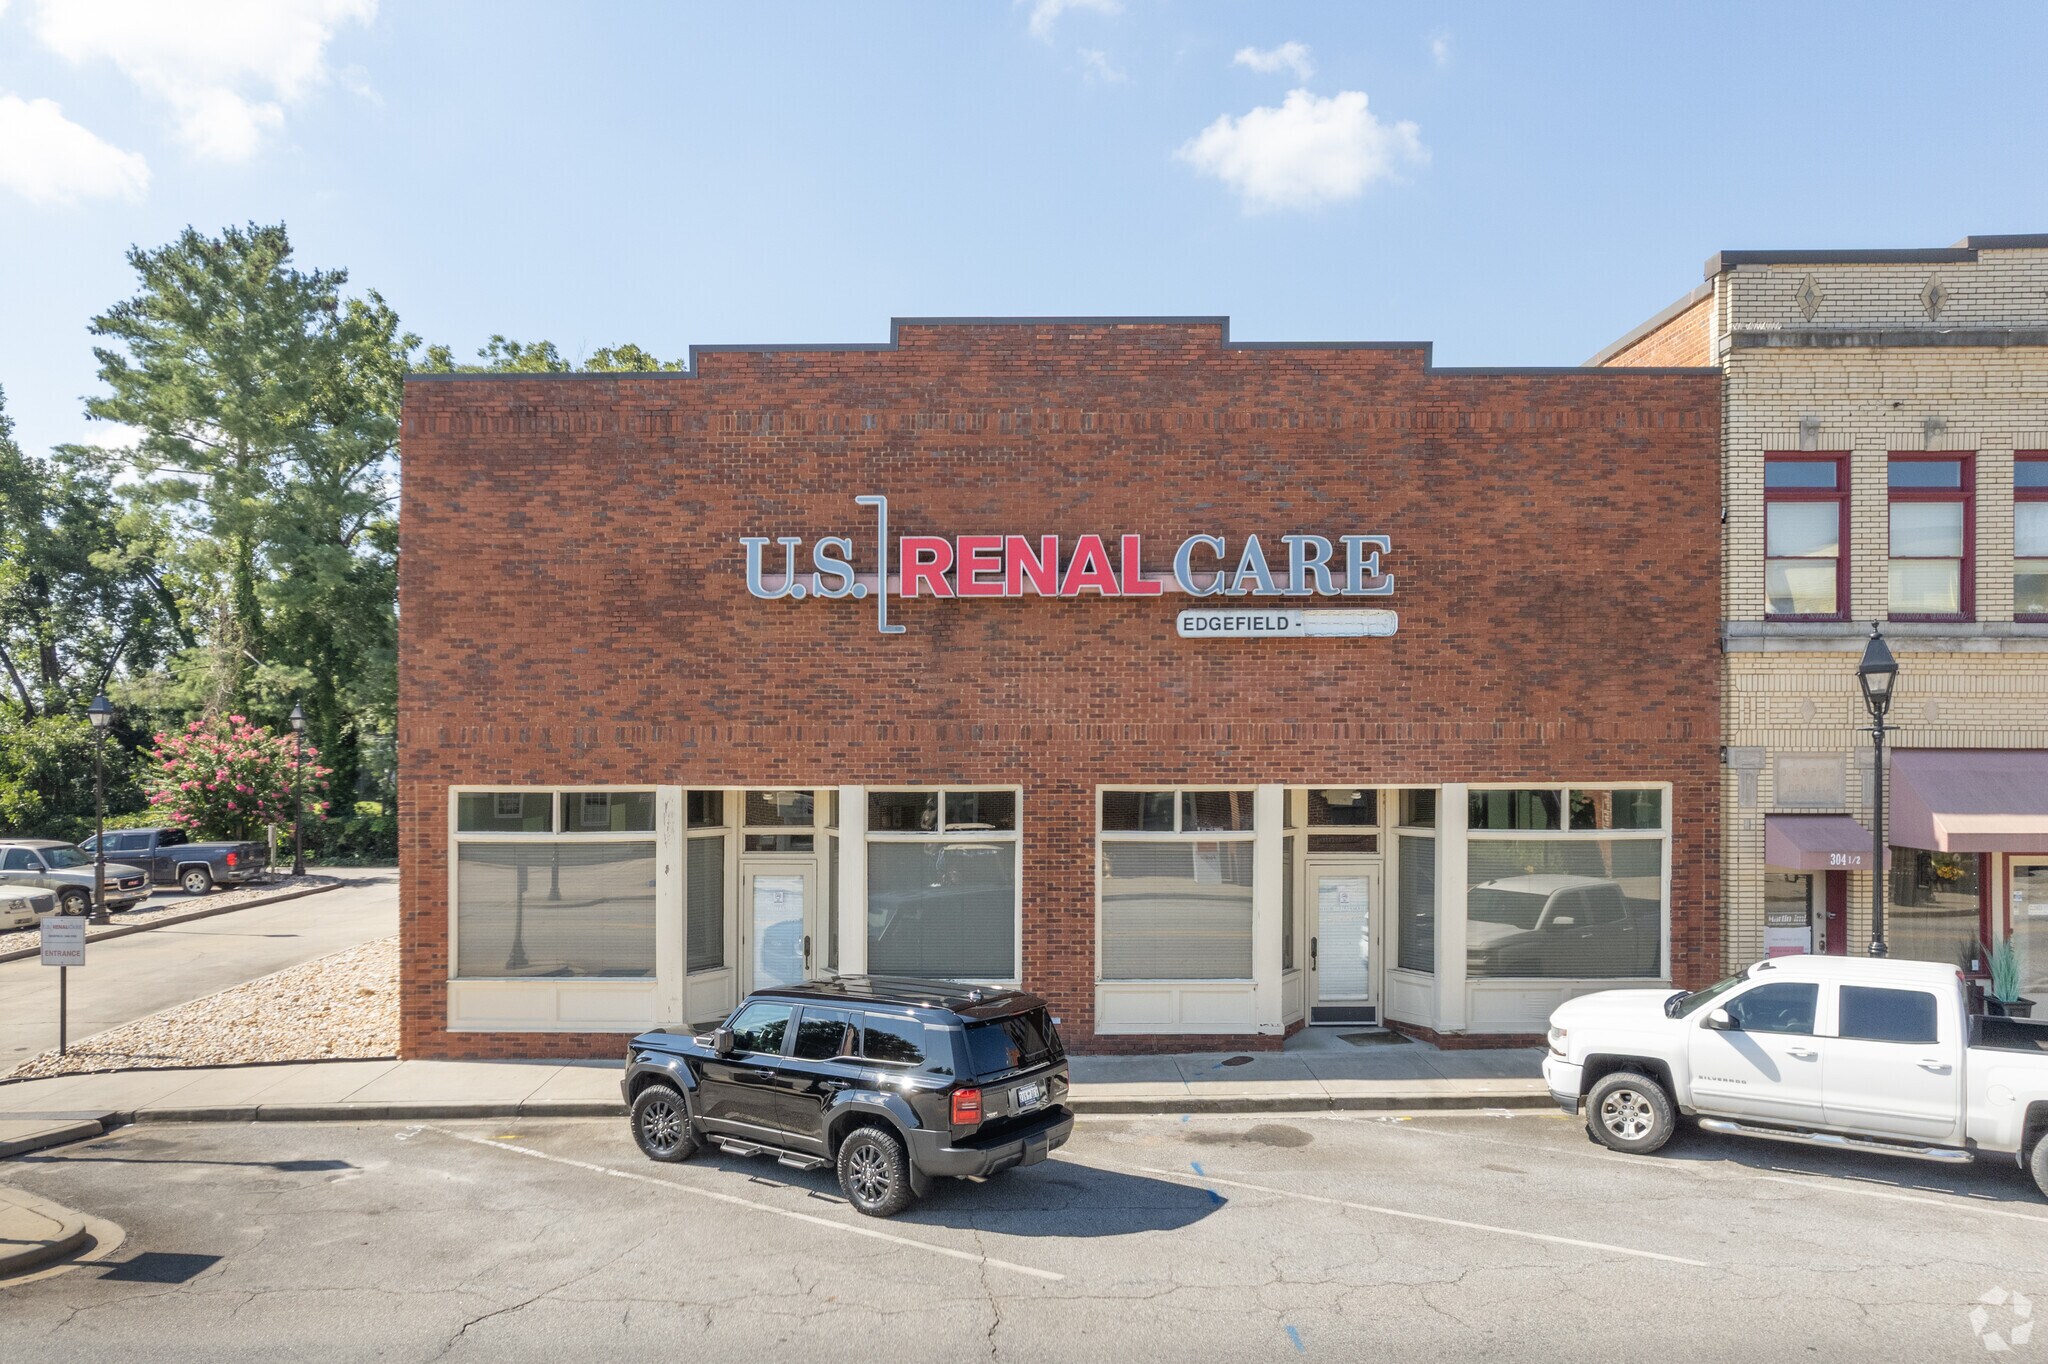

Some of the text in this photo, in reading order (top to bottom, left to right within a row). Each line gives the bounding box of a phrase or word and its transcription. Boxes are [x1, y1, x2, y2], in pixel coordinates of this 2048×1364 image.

[739, 534, 1395, 599] U.S. RENAL CARE
[1183, 616, 1289, 631] EDGEFIELD
[1830, 853, 1861, 866] 304 1/2
